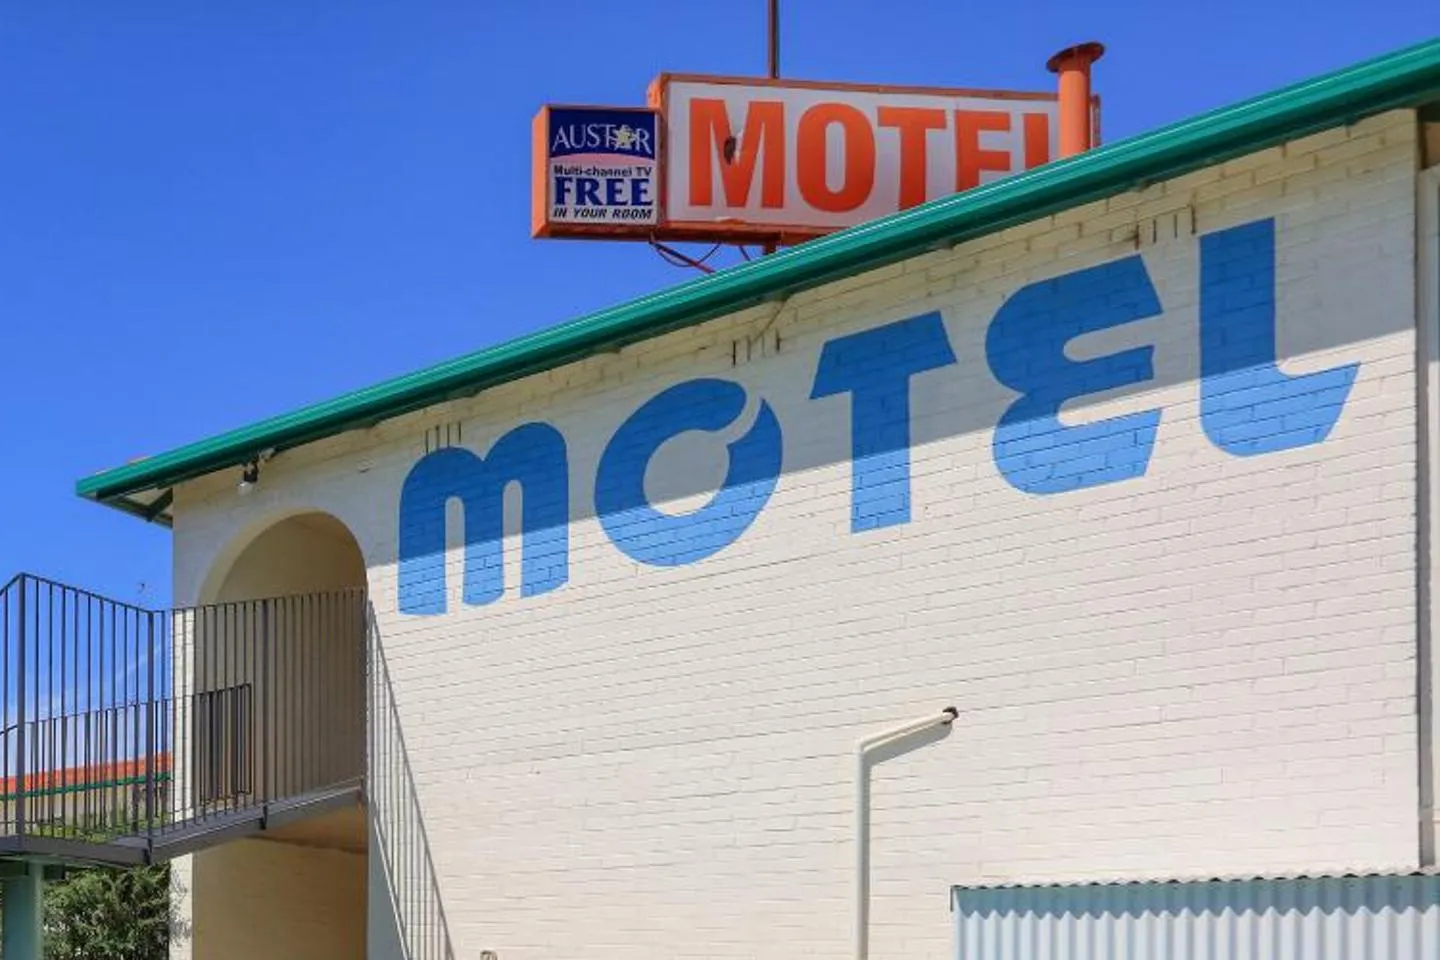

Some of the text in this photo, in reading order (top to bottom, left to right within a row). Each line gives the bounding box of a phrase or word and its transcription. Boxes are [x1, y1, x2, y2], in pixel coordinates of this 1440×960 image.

[553, 165, 652, 177] Multi-channel TV
[554, 176, 653, 206] FREE
[553, 208, 652, 219] IN YOUR ROOM
[397, 217, 1361, 616] MOTEL
